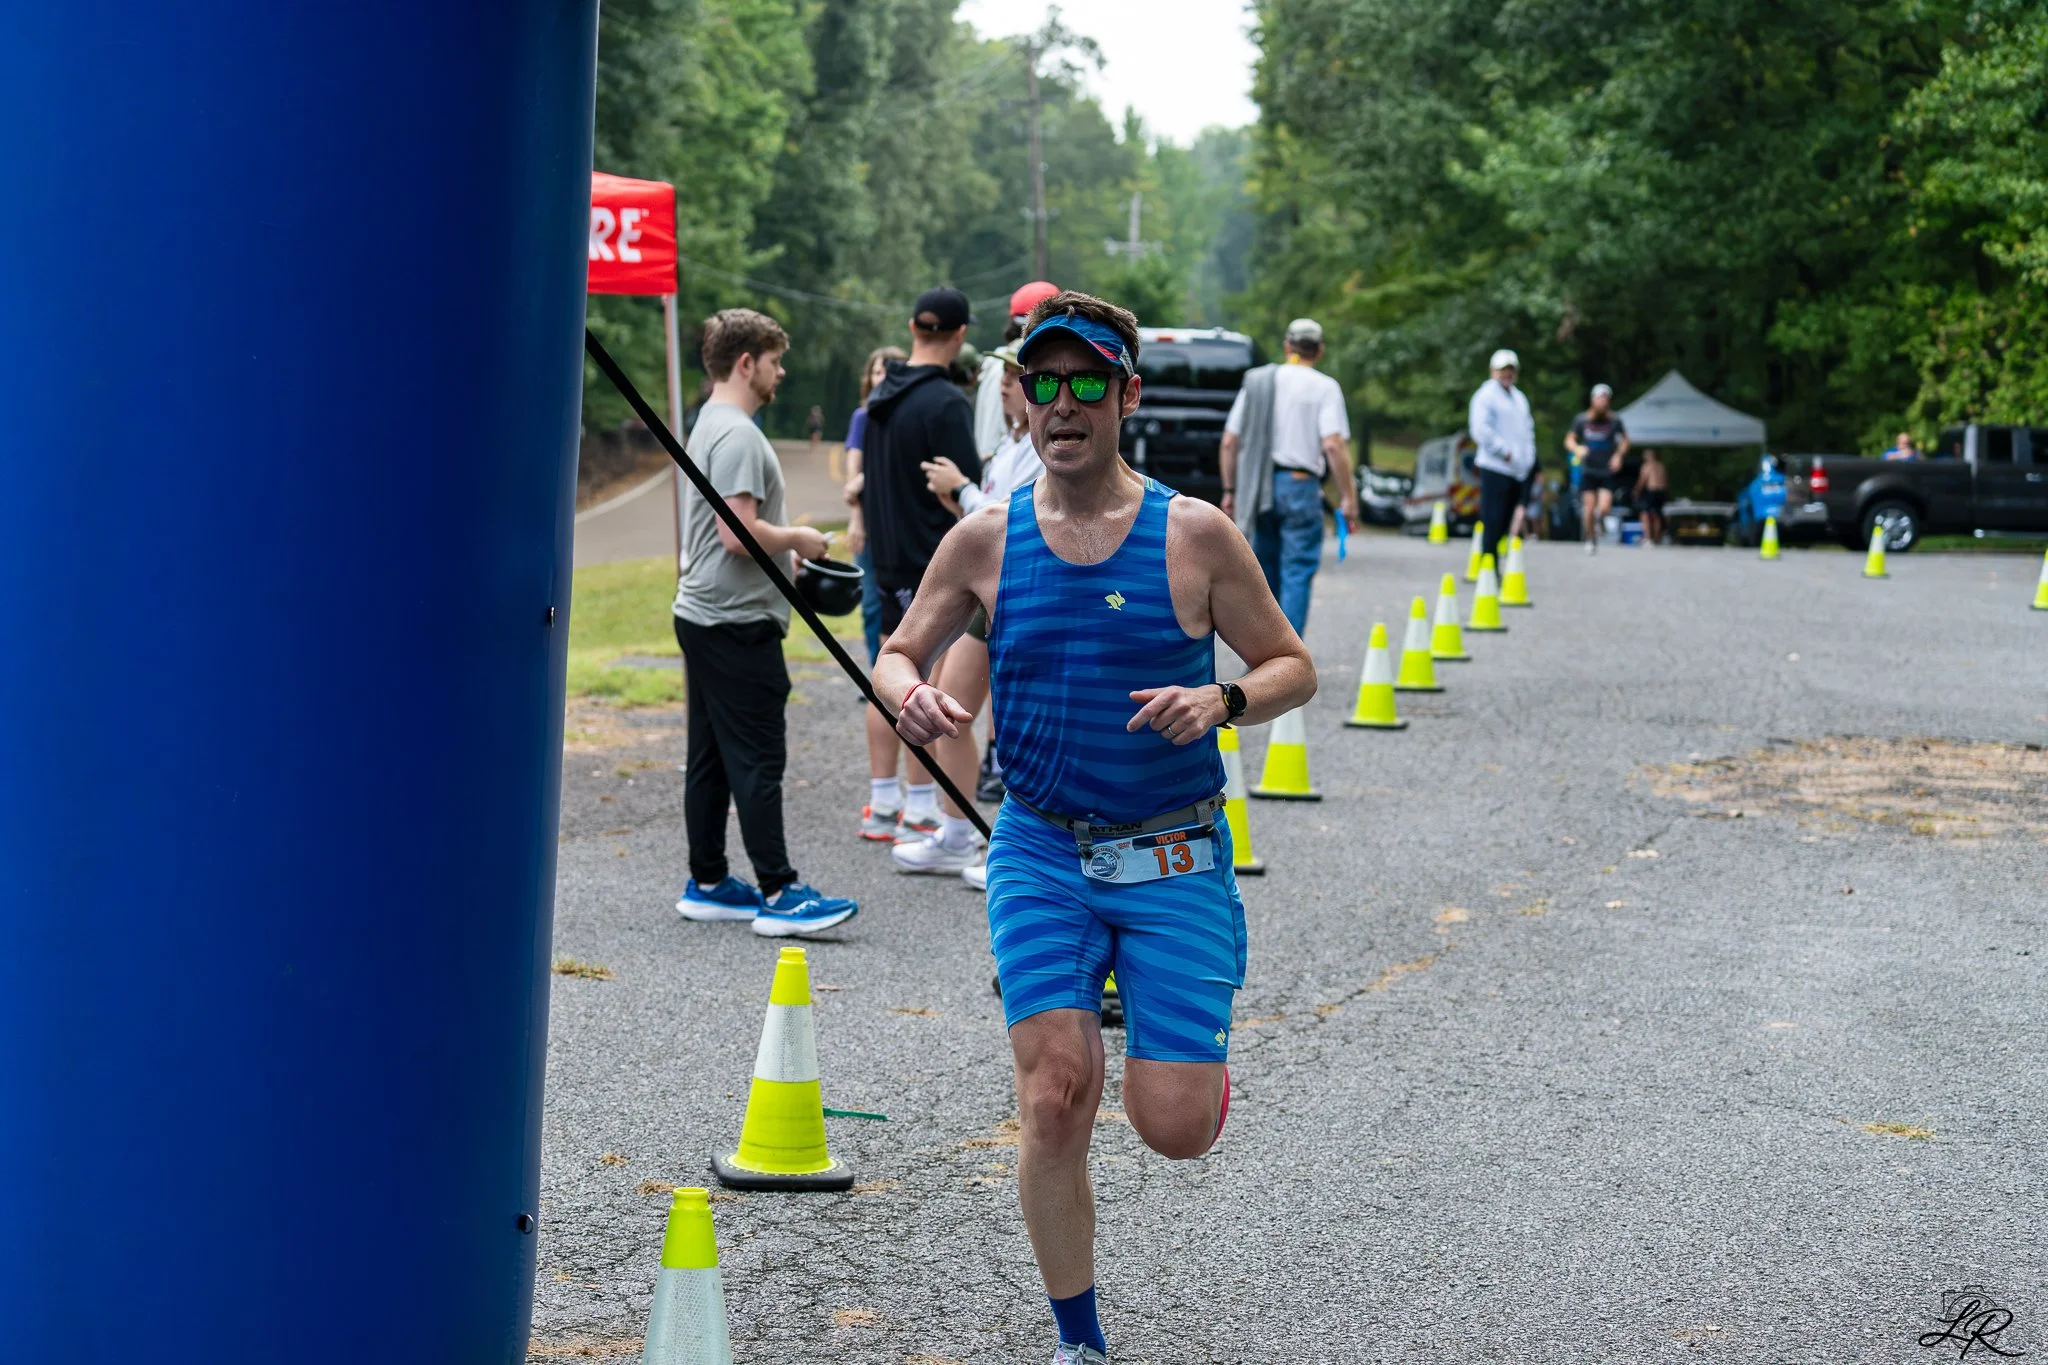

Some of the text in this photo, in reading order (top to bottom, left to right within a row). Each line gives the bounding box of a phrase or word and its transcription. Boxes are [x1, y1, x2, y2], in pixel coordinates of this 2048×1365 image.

[1088, 821, 1142, 834] ATHAN
[1155, 831, 1187, 845] VICTOR
[1152, 843, 1195, 876] 13
